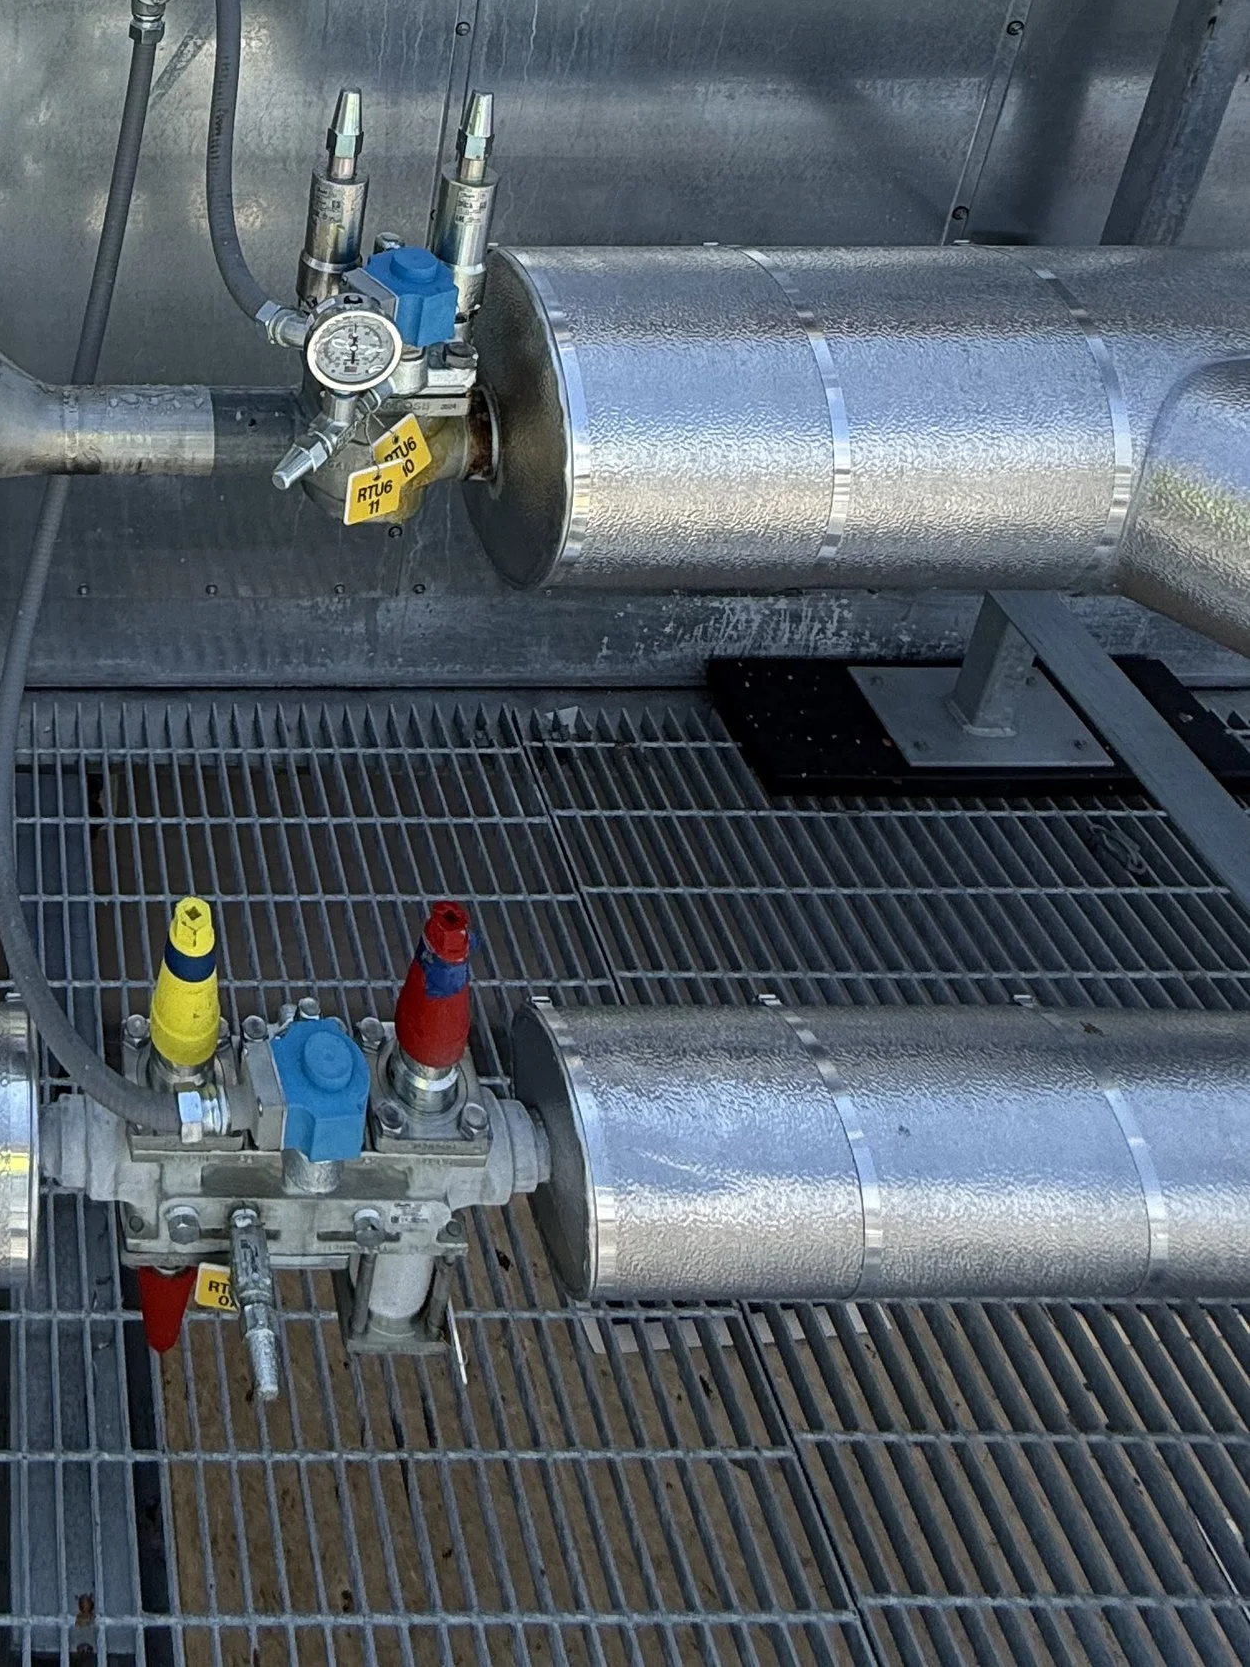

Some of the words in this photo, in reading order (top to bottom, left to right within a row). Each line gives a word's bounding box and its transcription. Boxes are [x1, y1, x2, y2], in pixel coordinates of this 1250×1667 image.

[384, 435, 418, 463] RTU6
[401, 458, 415, 478] 10
[357, 479, 393, 504] RTU6
[368, 498, 380, 515] 11
[208, 1279, 231, 1295] RT
